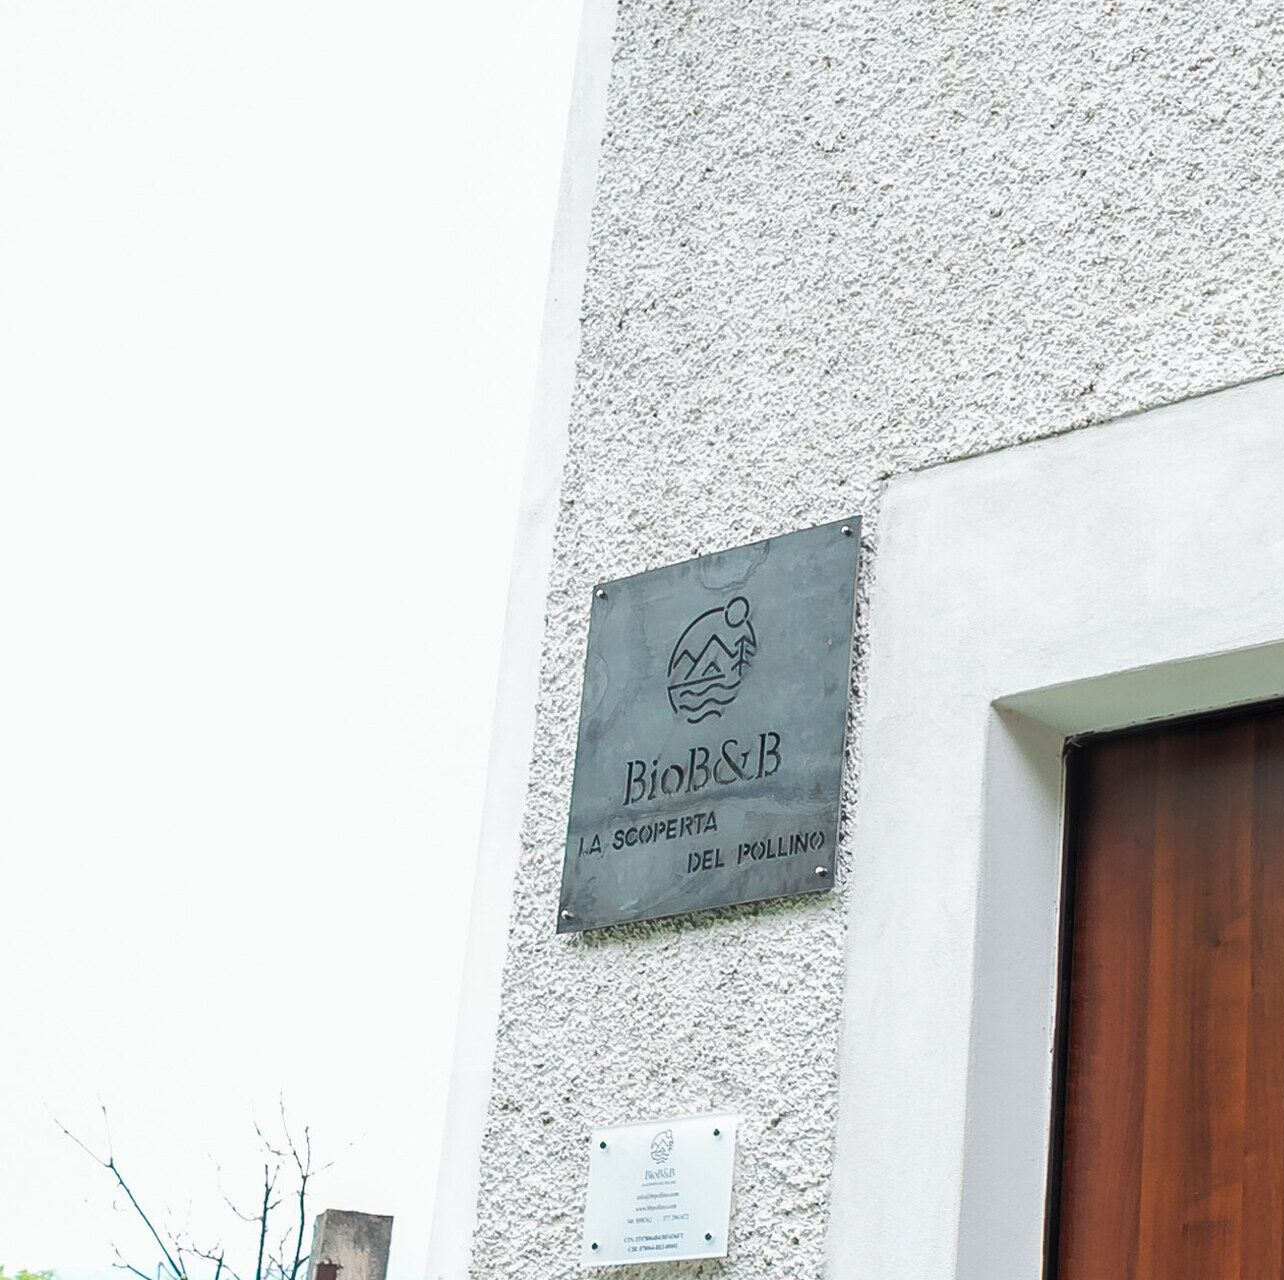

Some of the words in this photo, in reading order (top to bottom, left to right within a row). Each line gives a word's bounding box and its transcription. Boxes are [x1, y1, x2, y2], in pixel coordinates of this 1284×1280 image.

[623, 732, 781, 807] BioB&B
[578, 834, 602, 858] LA
[612, 810, 718, 851] SCOPERTA
[687, 848, 725, 873] DEL
[737, 830, 826, 865] POLLINO
